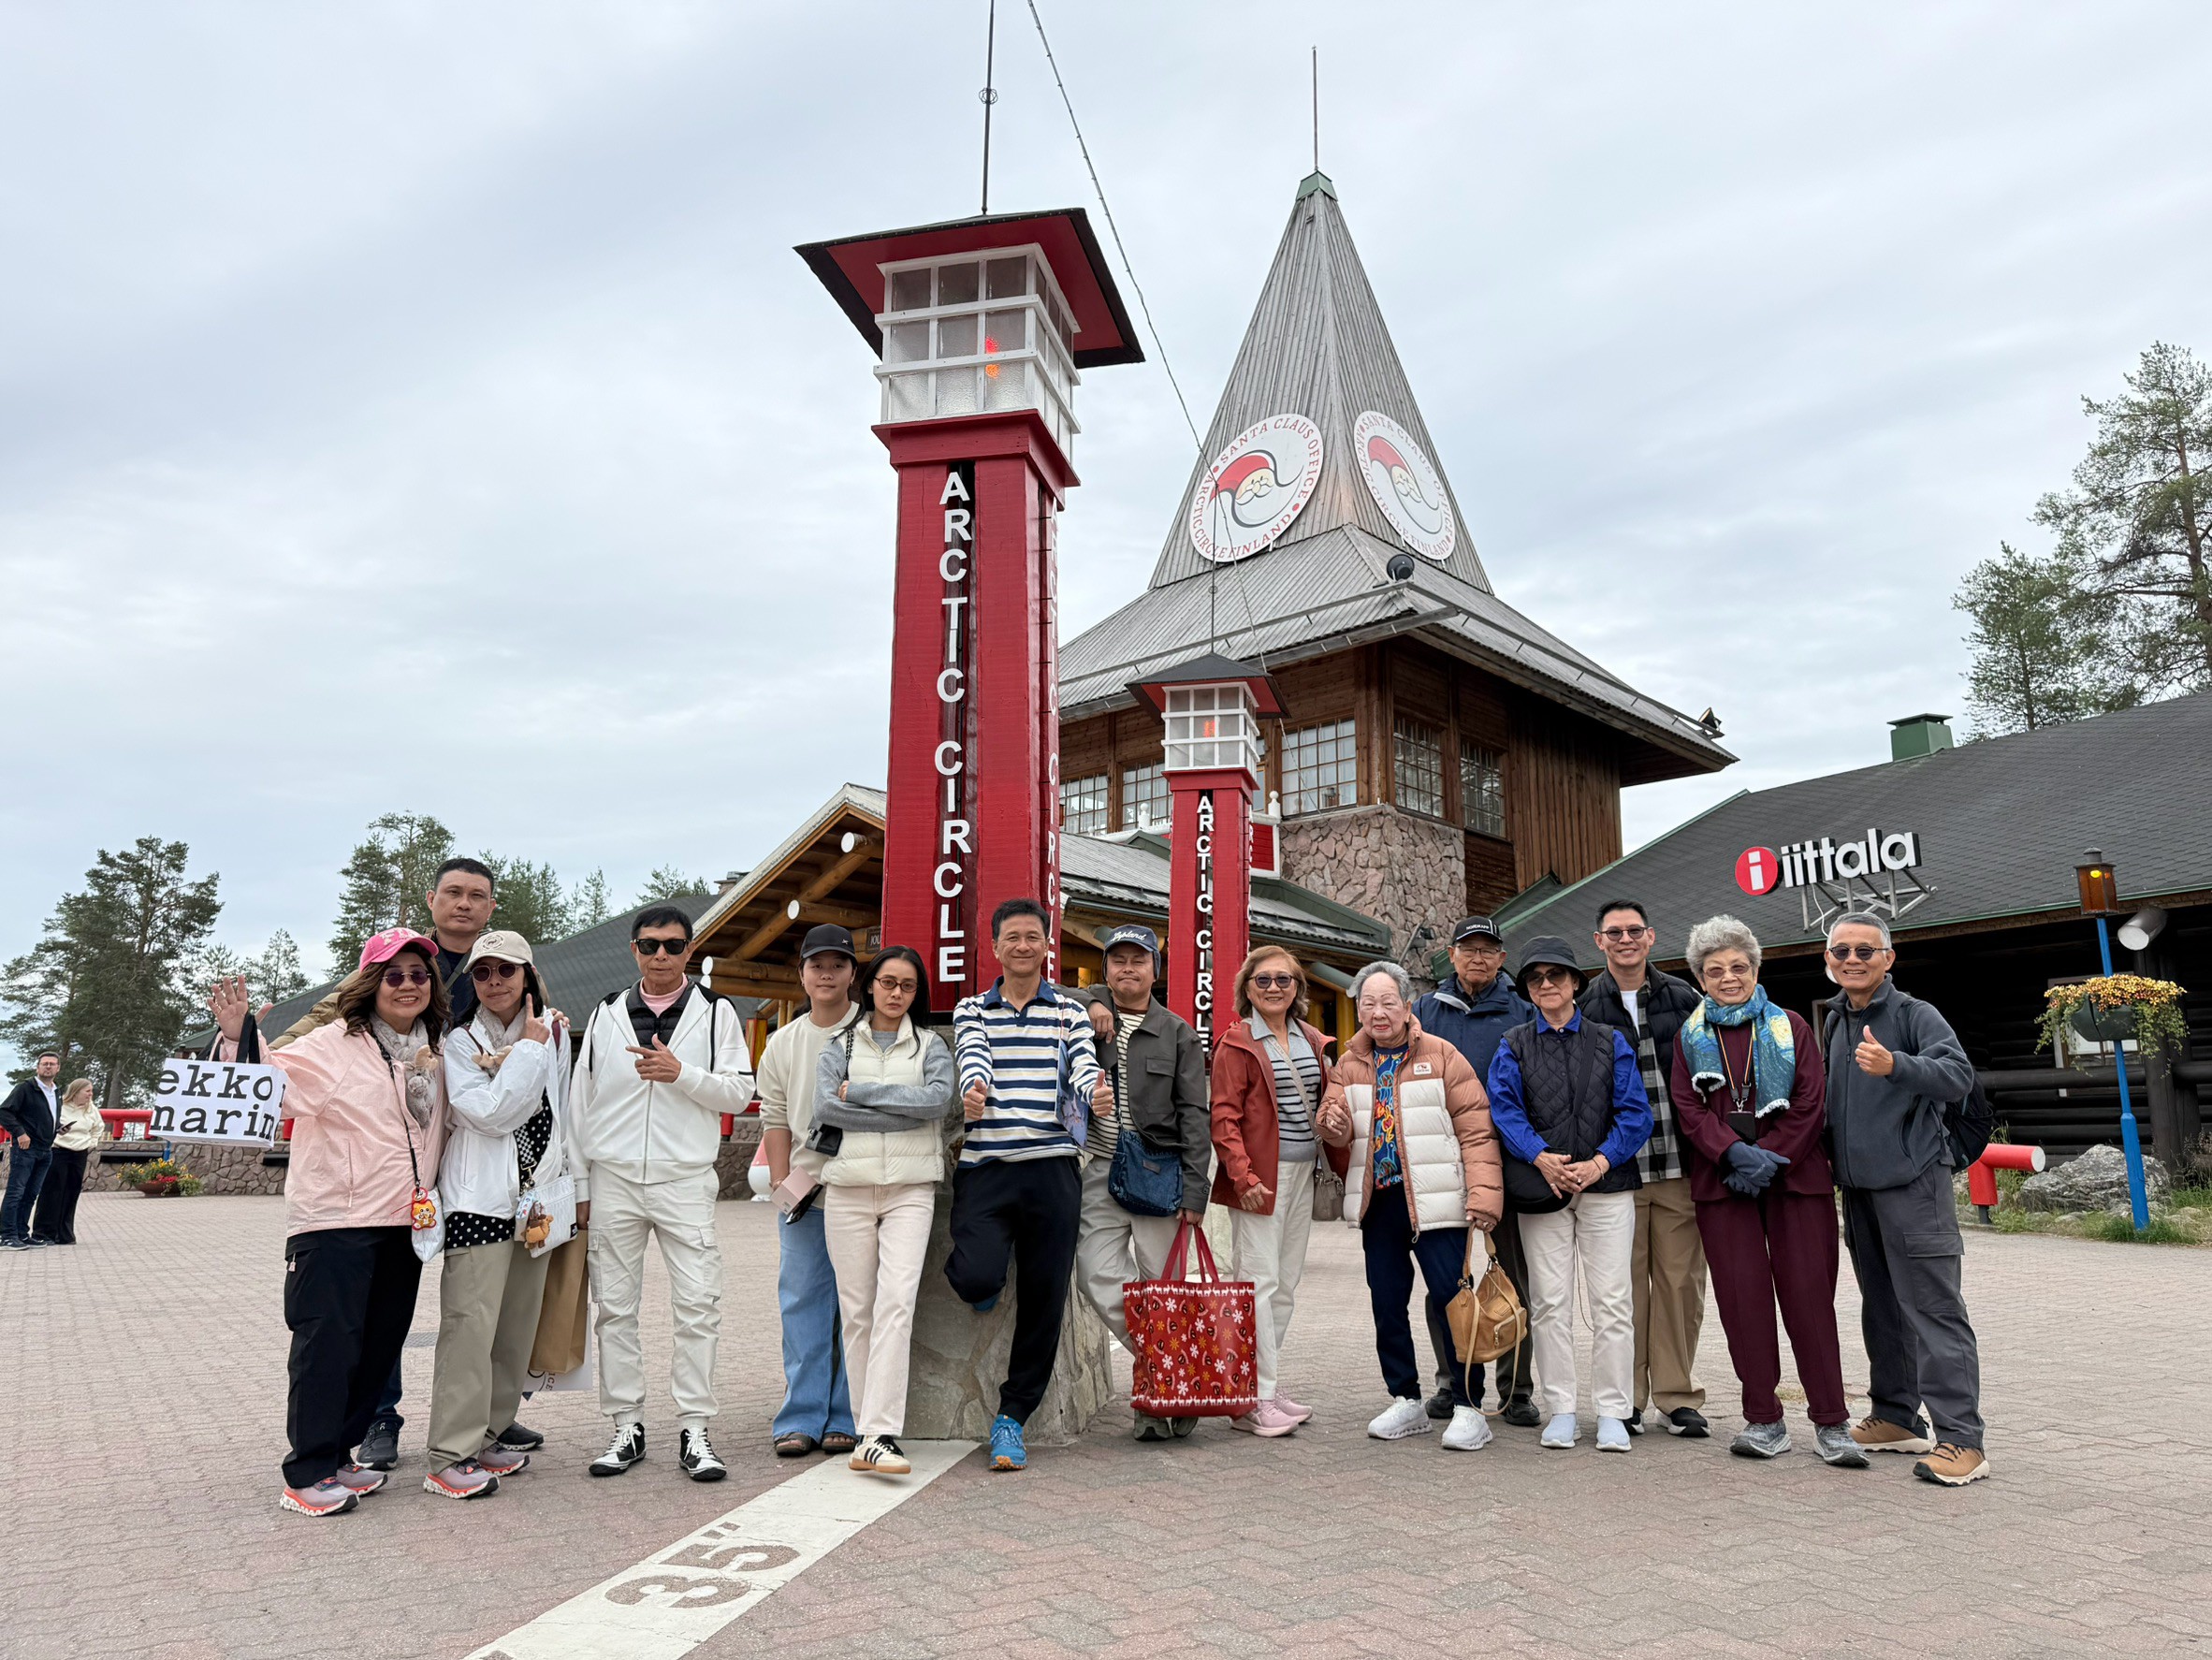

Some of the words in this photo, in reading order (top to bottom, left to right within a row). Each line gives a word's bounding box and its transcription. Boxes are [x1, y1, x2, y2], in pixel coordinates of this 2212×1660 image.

[1220, 423, 1268, 464] SANTA
[1273, 417, 1314, 440] CLAUS
[1298, 439, 1320, 499] OFFICE
[1361, 414, 1394, 431] SANTA
[1397, 429, 1433, 474] CLAUS
[1192, 474, 1214, 529] ARCTIC
[1356, 430, 1374, 483] ARCTIC
[1371, 486, 1409, 540] CIRCLE
[1410, 533, 1449, 557] FINLAND
[1195, 529, 1228, 559] CIRCLE
[1228, 514, 1291, 559] FINLAND
[937, 471, 972, 703] ARCTIC
[934, 741, 971, 982] CIRCLE
[1196, 795, 1215, 913] ARCTIC
[1781, 828, 1916, 888] iittala
[1195, 930, 1214, 1053] CIRCLE
